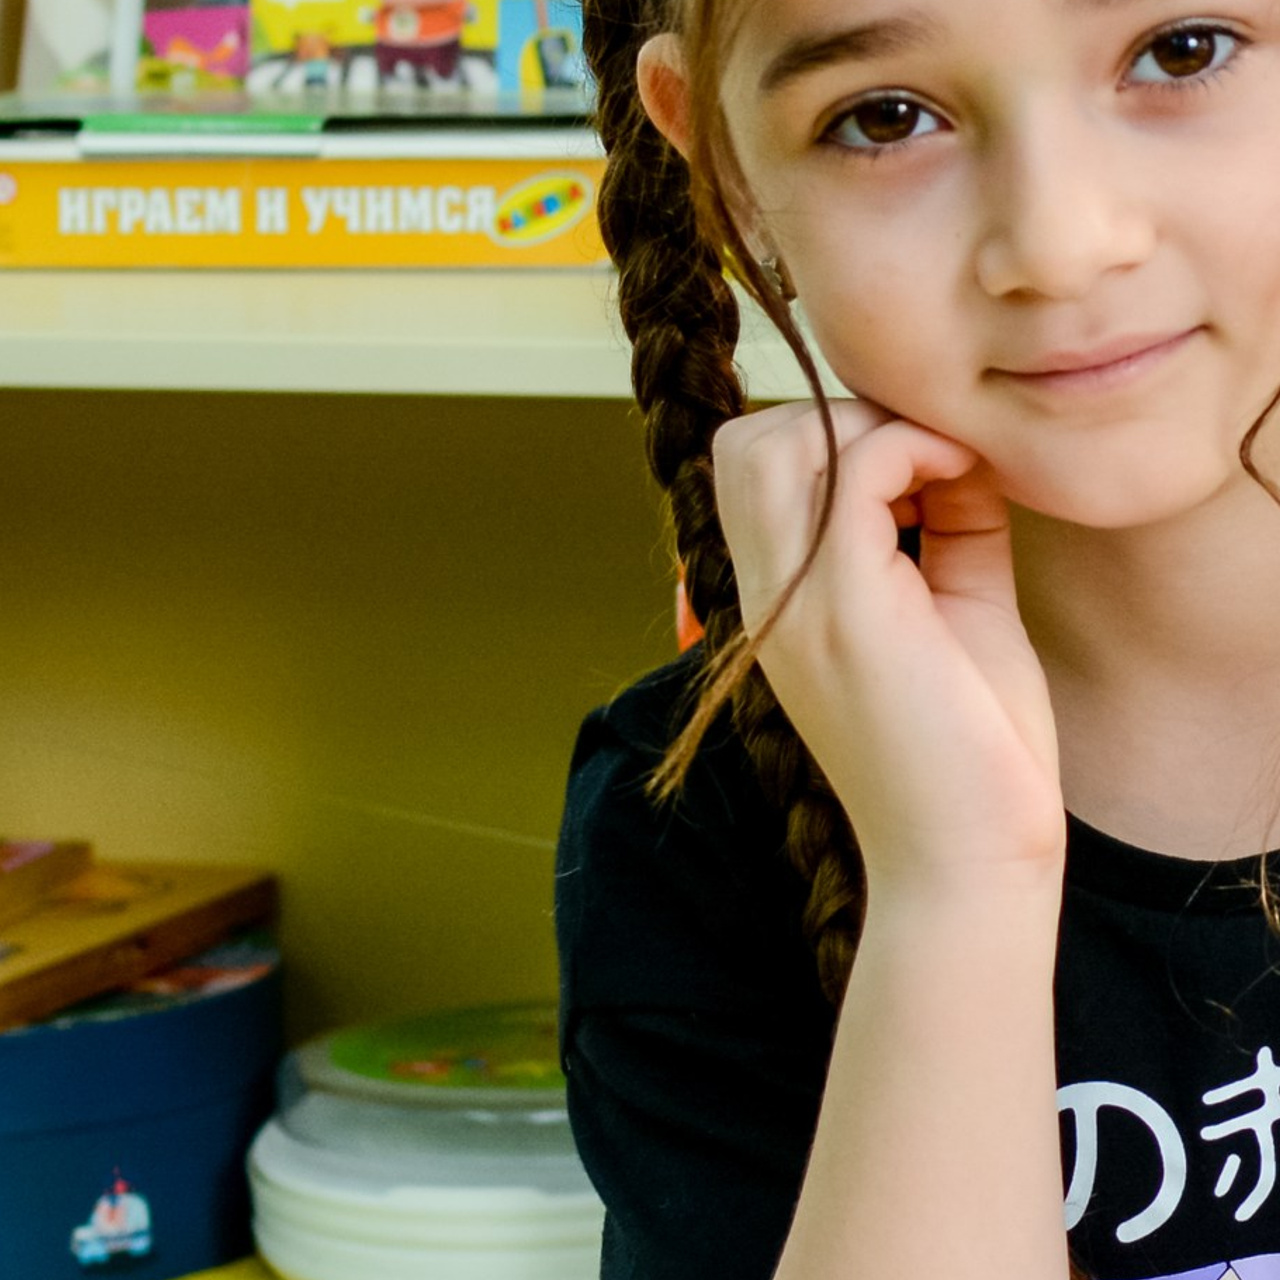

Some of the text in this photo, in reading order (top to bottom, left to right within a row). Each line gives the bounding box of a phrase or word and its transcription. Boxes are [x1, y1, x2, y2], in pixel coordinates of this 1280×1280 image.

[58, 186, 242, 234] ИГРАЕМ
[256, 186, 289, 234] И
[301, 186, 496, 234] УЧИМСЯ
